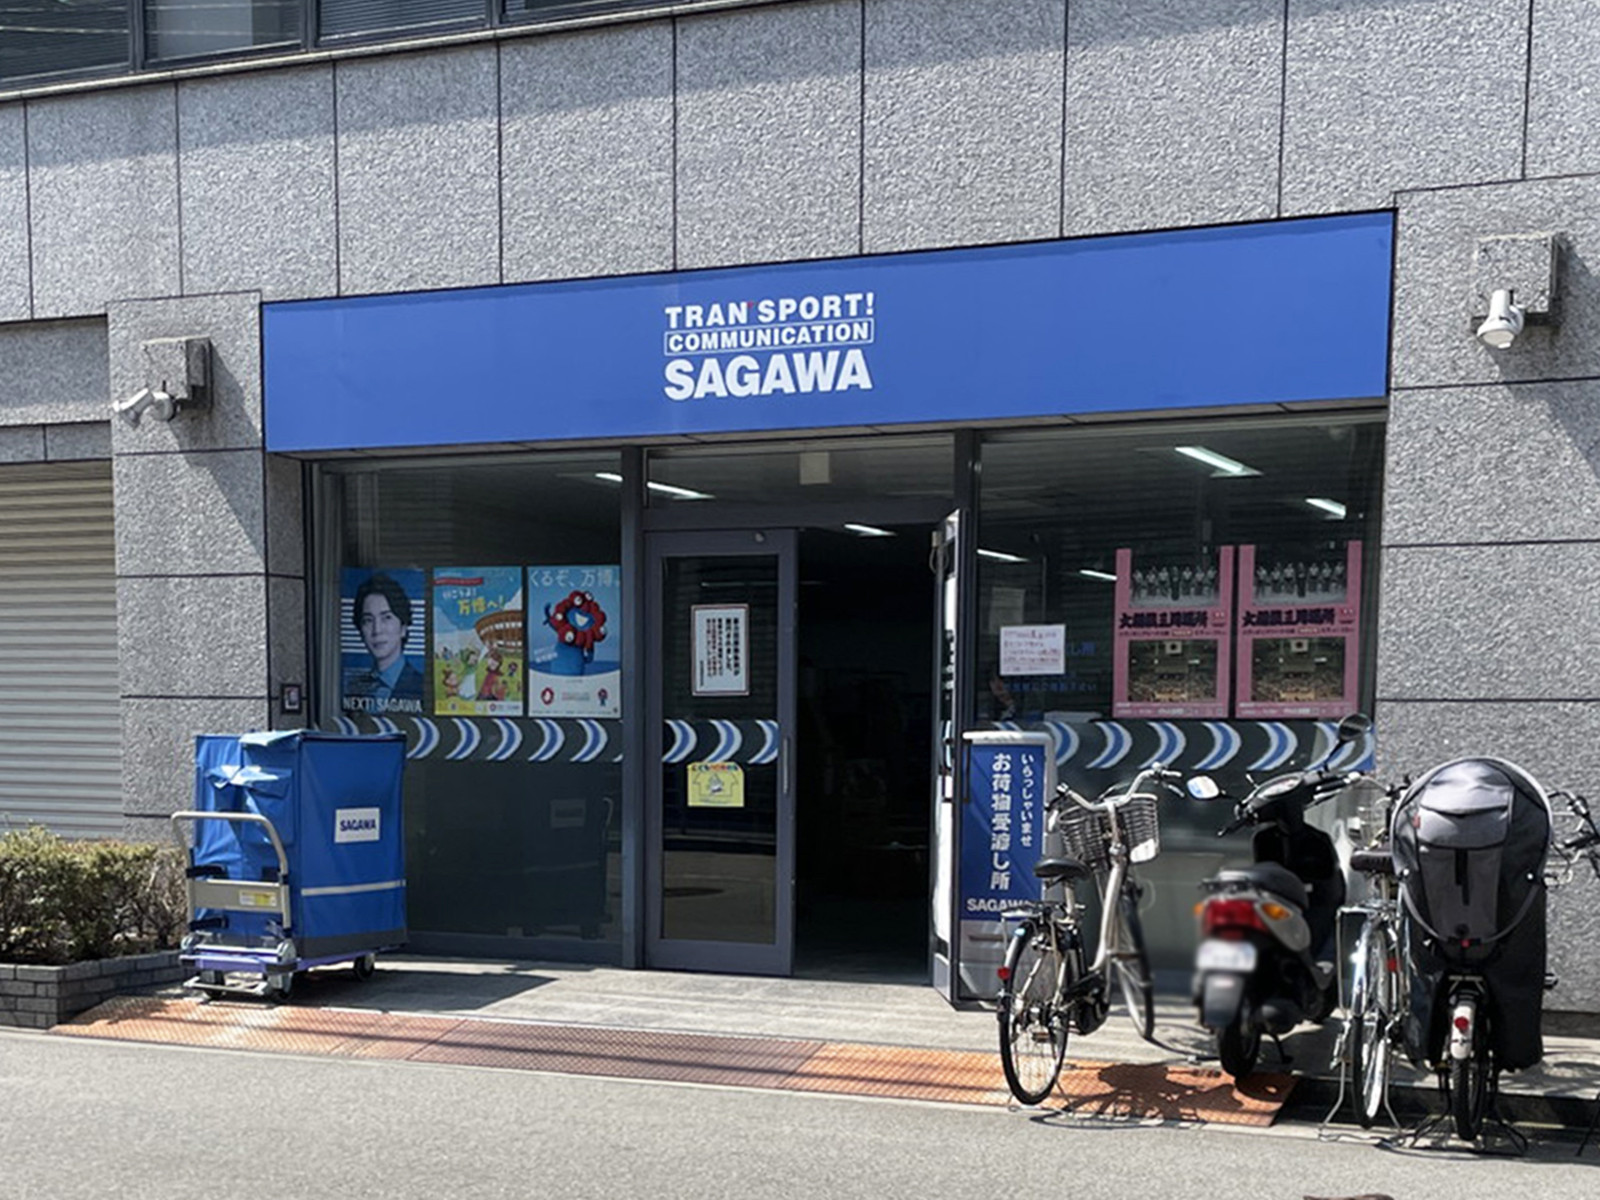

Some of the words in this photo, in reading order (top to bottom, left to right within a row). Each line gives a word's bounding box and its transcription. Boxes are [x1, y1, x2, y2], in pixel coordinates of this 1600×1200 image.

[668, 321, 869, 352] COMMUNICATION
[664, 349, 873, 400] SAGAWA
[376, 698, 422, 714] SAGAWA
[1021, 754, 1034, 847] いらっしゃいませ
[340, 819, 376, 831] SAGAWA
[991, 753, 1011, 890] お荷物受渡し所
[967, 898, 1033, 911] SAGAW
